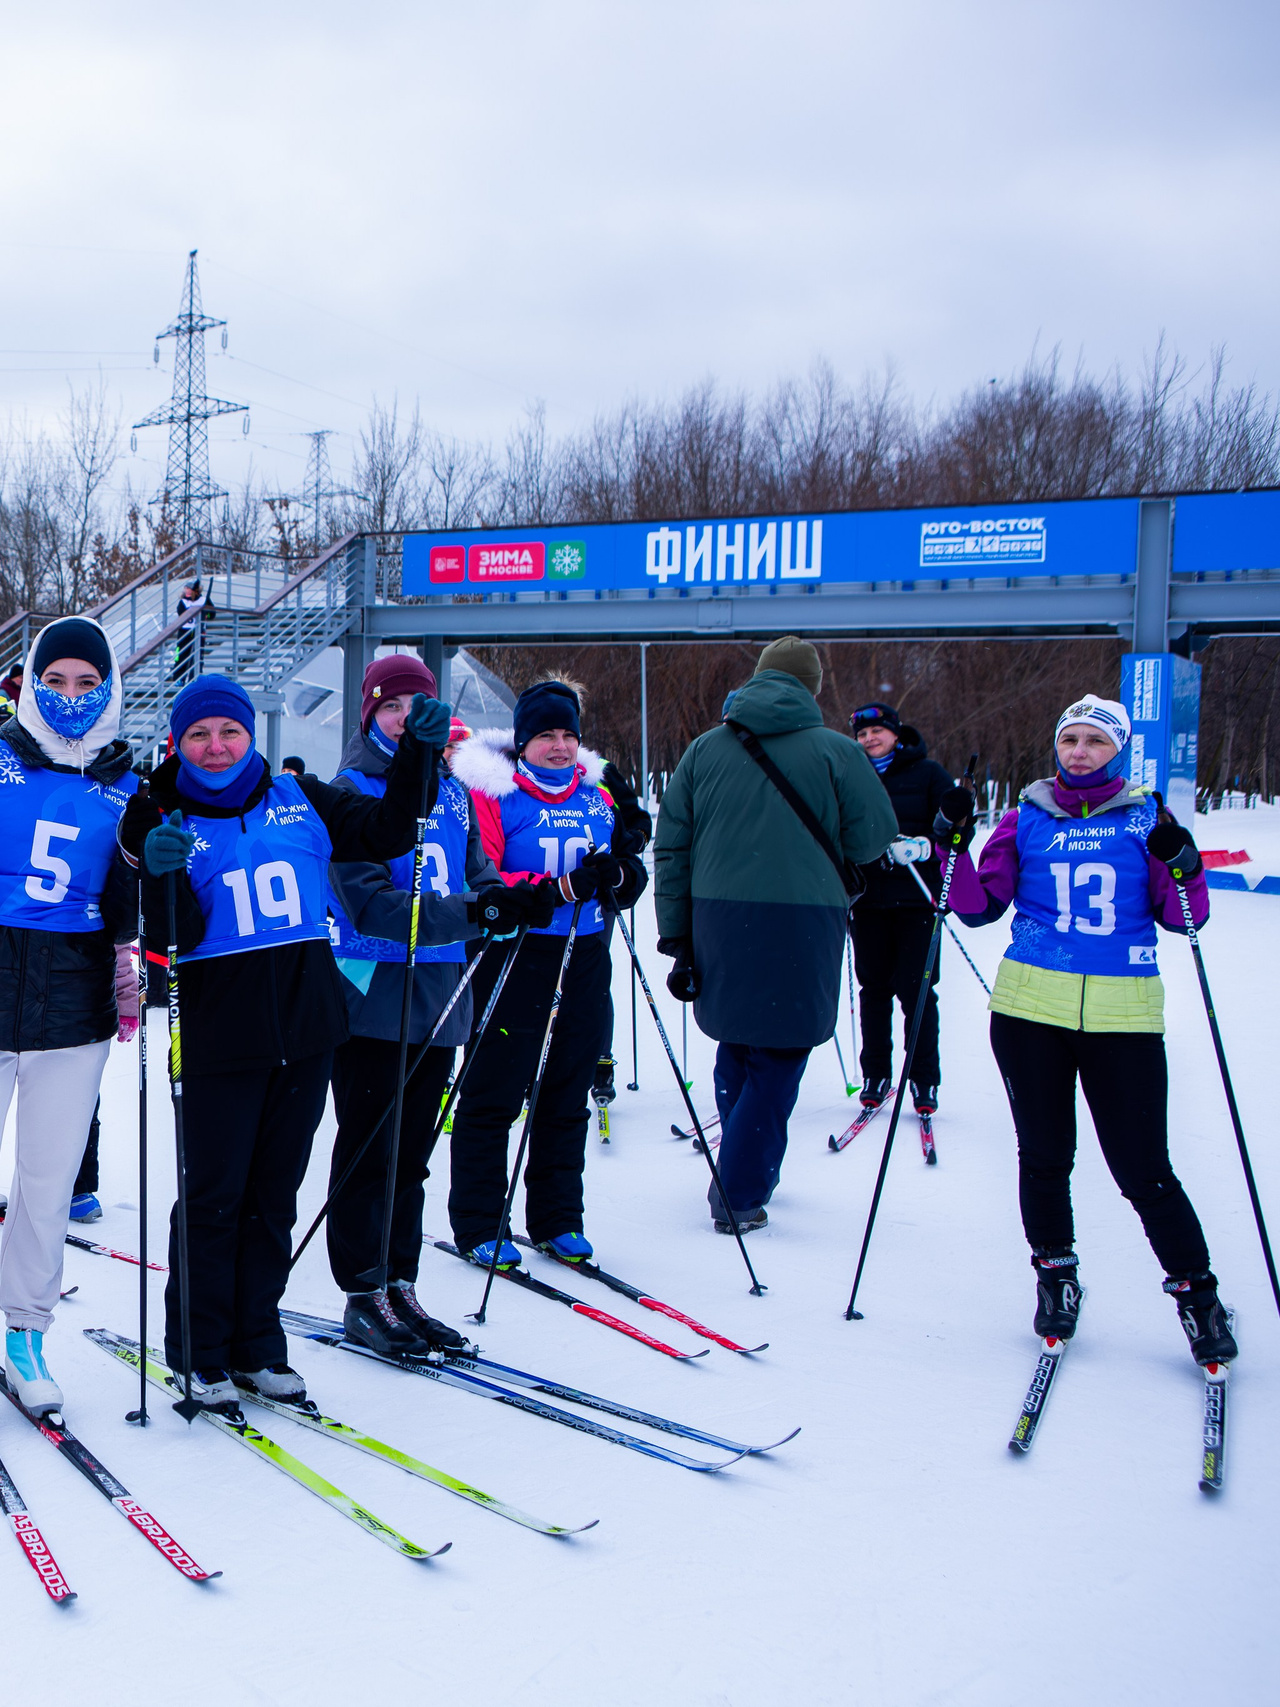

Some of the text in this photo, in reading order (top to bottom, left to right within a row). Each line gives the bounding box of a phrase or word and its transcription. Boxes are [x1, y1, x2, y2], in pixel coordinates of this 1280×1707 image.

[478, 549, 533, 567] ЗИМА
[478, 564, 533, 576] В МОСКВЕ
[646, 520, 823, 583] ФИНИШ
[549, 808, 585, 818] ЛЫЖНЯ
[553, 818, 580, 829] МОЭК
[1068, 826, 1116, 838] ЛЫЖНЯ
[24, 818, 81, 904] 5
[1068, 840, 1102, 851] МОЭК
[222, 860, 303, 937] 19
[938, 848, 958, 910] NORDWAY
[1049, 862, 1117, 936] 13
[1175, 883, 1199, 946] NORDWAY
[10, 1513, 34, 1531] A3
[116, 1499, 142, 1513] A3
[20, 1528, 69, 1598] BRADOS
[131, 1512, 205, 1578] BRADOS
